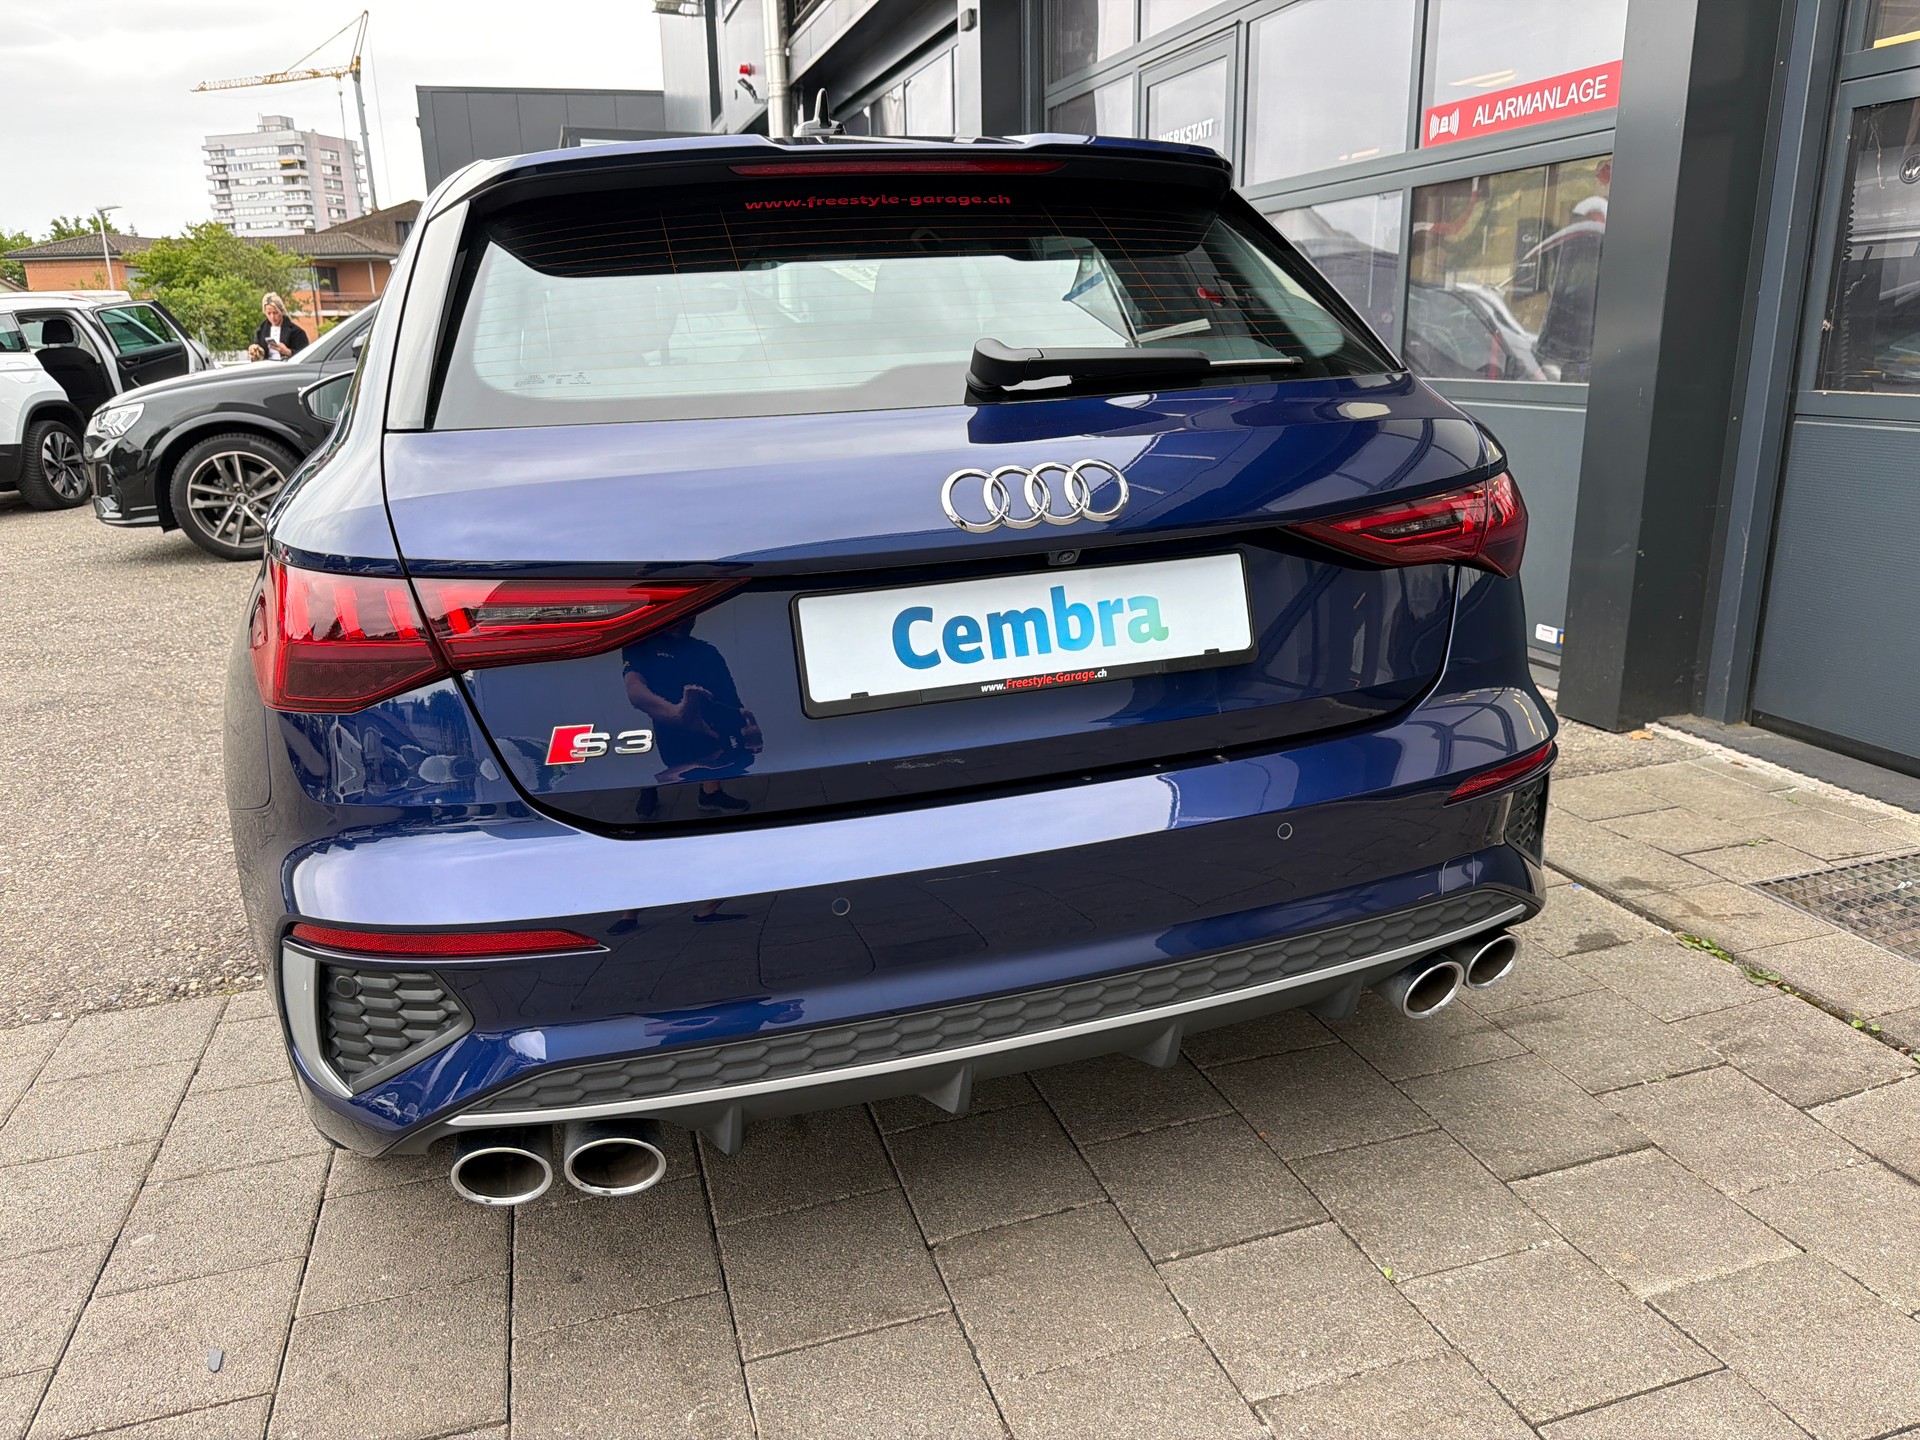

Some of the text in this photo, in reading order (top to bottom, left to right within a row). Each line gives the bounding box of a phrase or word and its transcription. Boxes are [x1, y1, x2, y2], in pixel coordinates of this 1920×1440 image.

[1472, 74, 1609, 127] ALARMANLAGE
[744, 194, 1011, 210] www.freestyle-garage.ch
[892, 586, 1169, 670] Cembra
[981, 668, 1107, 692] www.Freestyle-Garage.ch
[570, 729, 653, 758] S3
